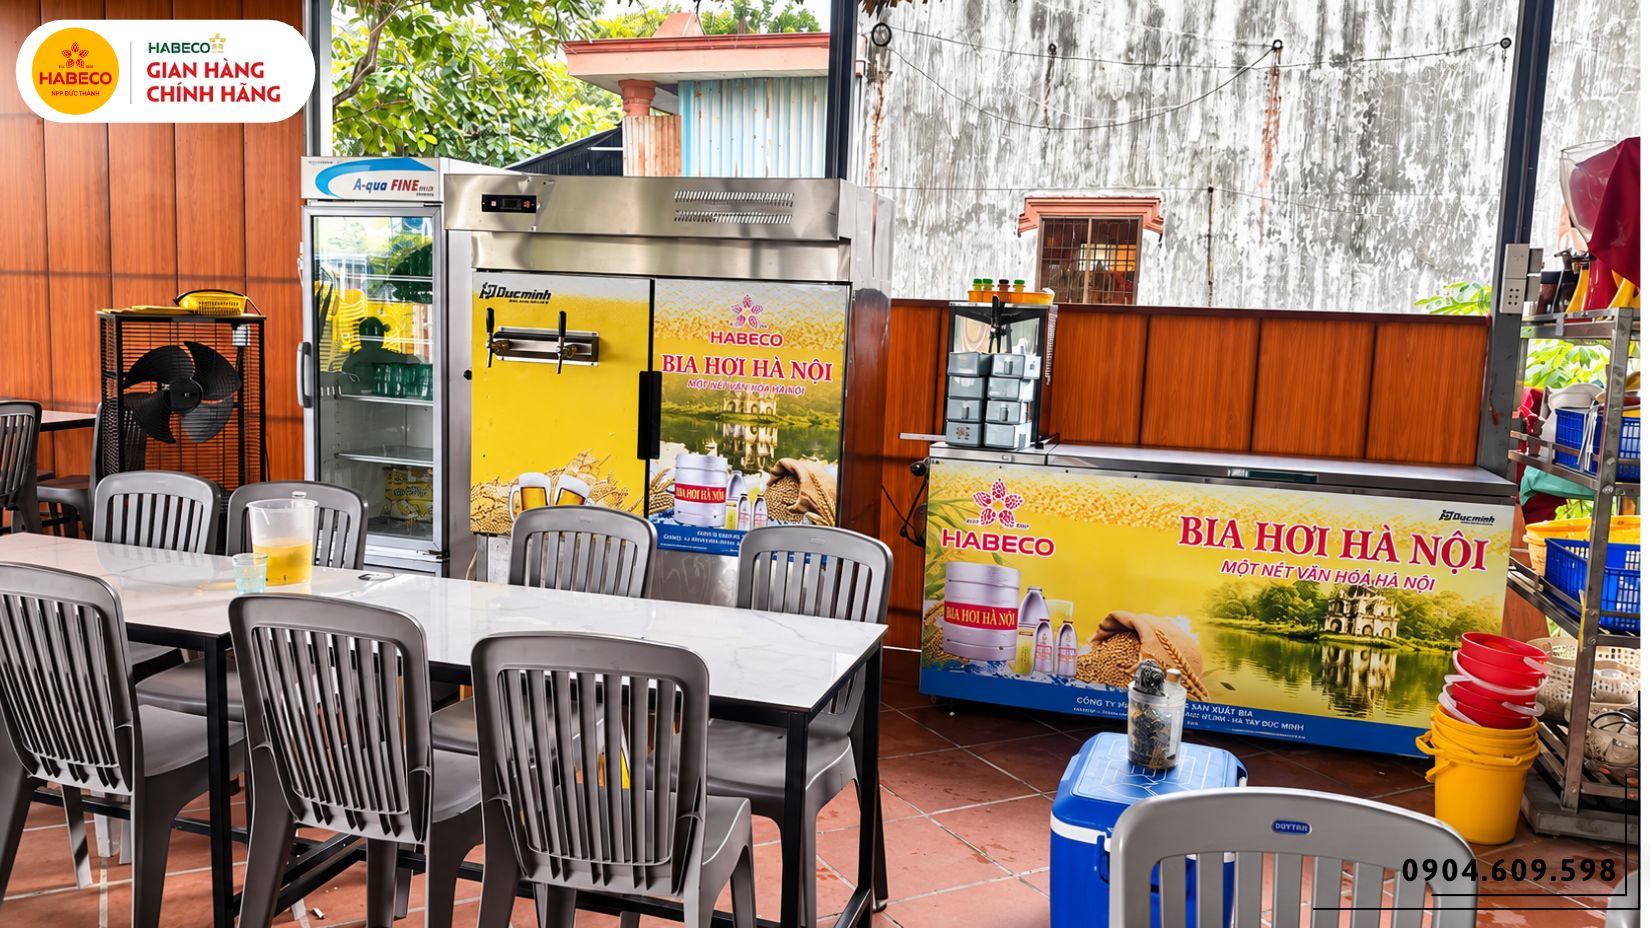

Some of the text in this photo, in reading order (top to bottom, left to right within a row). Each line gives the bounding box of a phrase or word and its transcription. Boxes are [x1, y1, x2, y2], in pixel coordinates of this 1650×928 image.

[353, 178, 420, 193] A-qua FINE
[710, 331, 783, 347] HABECO
[661, 354, 833, 384] BIA HƠI HÀ NỘI
[942, 528, 1055, 557] HABECO
[1178, 515, 1490, 575] BIA HƠI HÀ NỘI
[1221, 559, 1259, 578] MỘT
[1260, 563, 1295, 580] NÉT
[1403, 574, 1436, 594] NỘI
